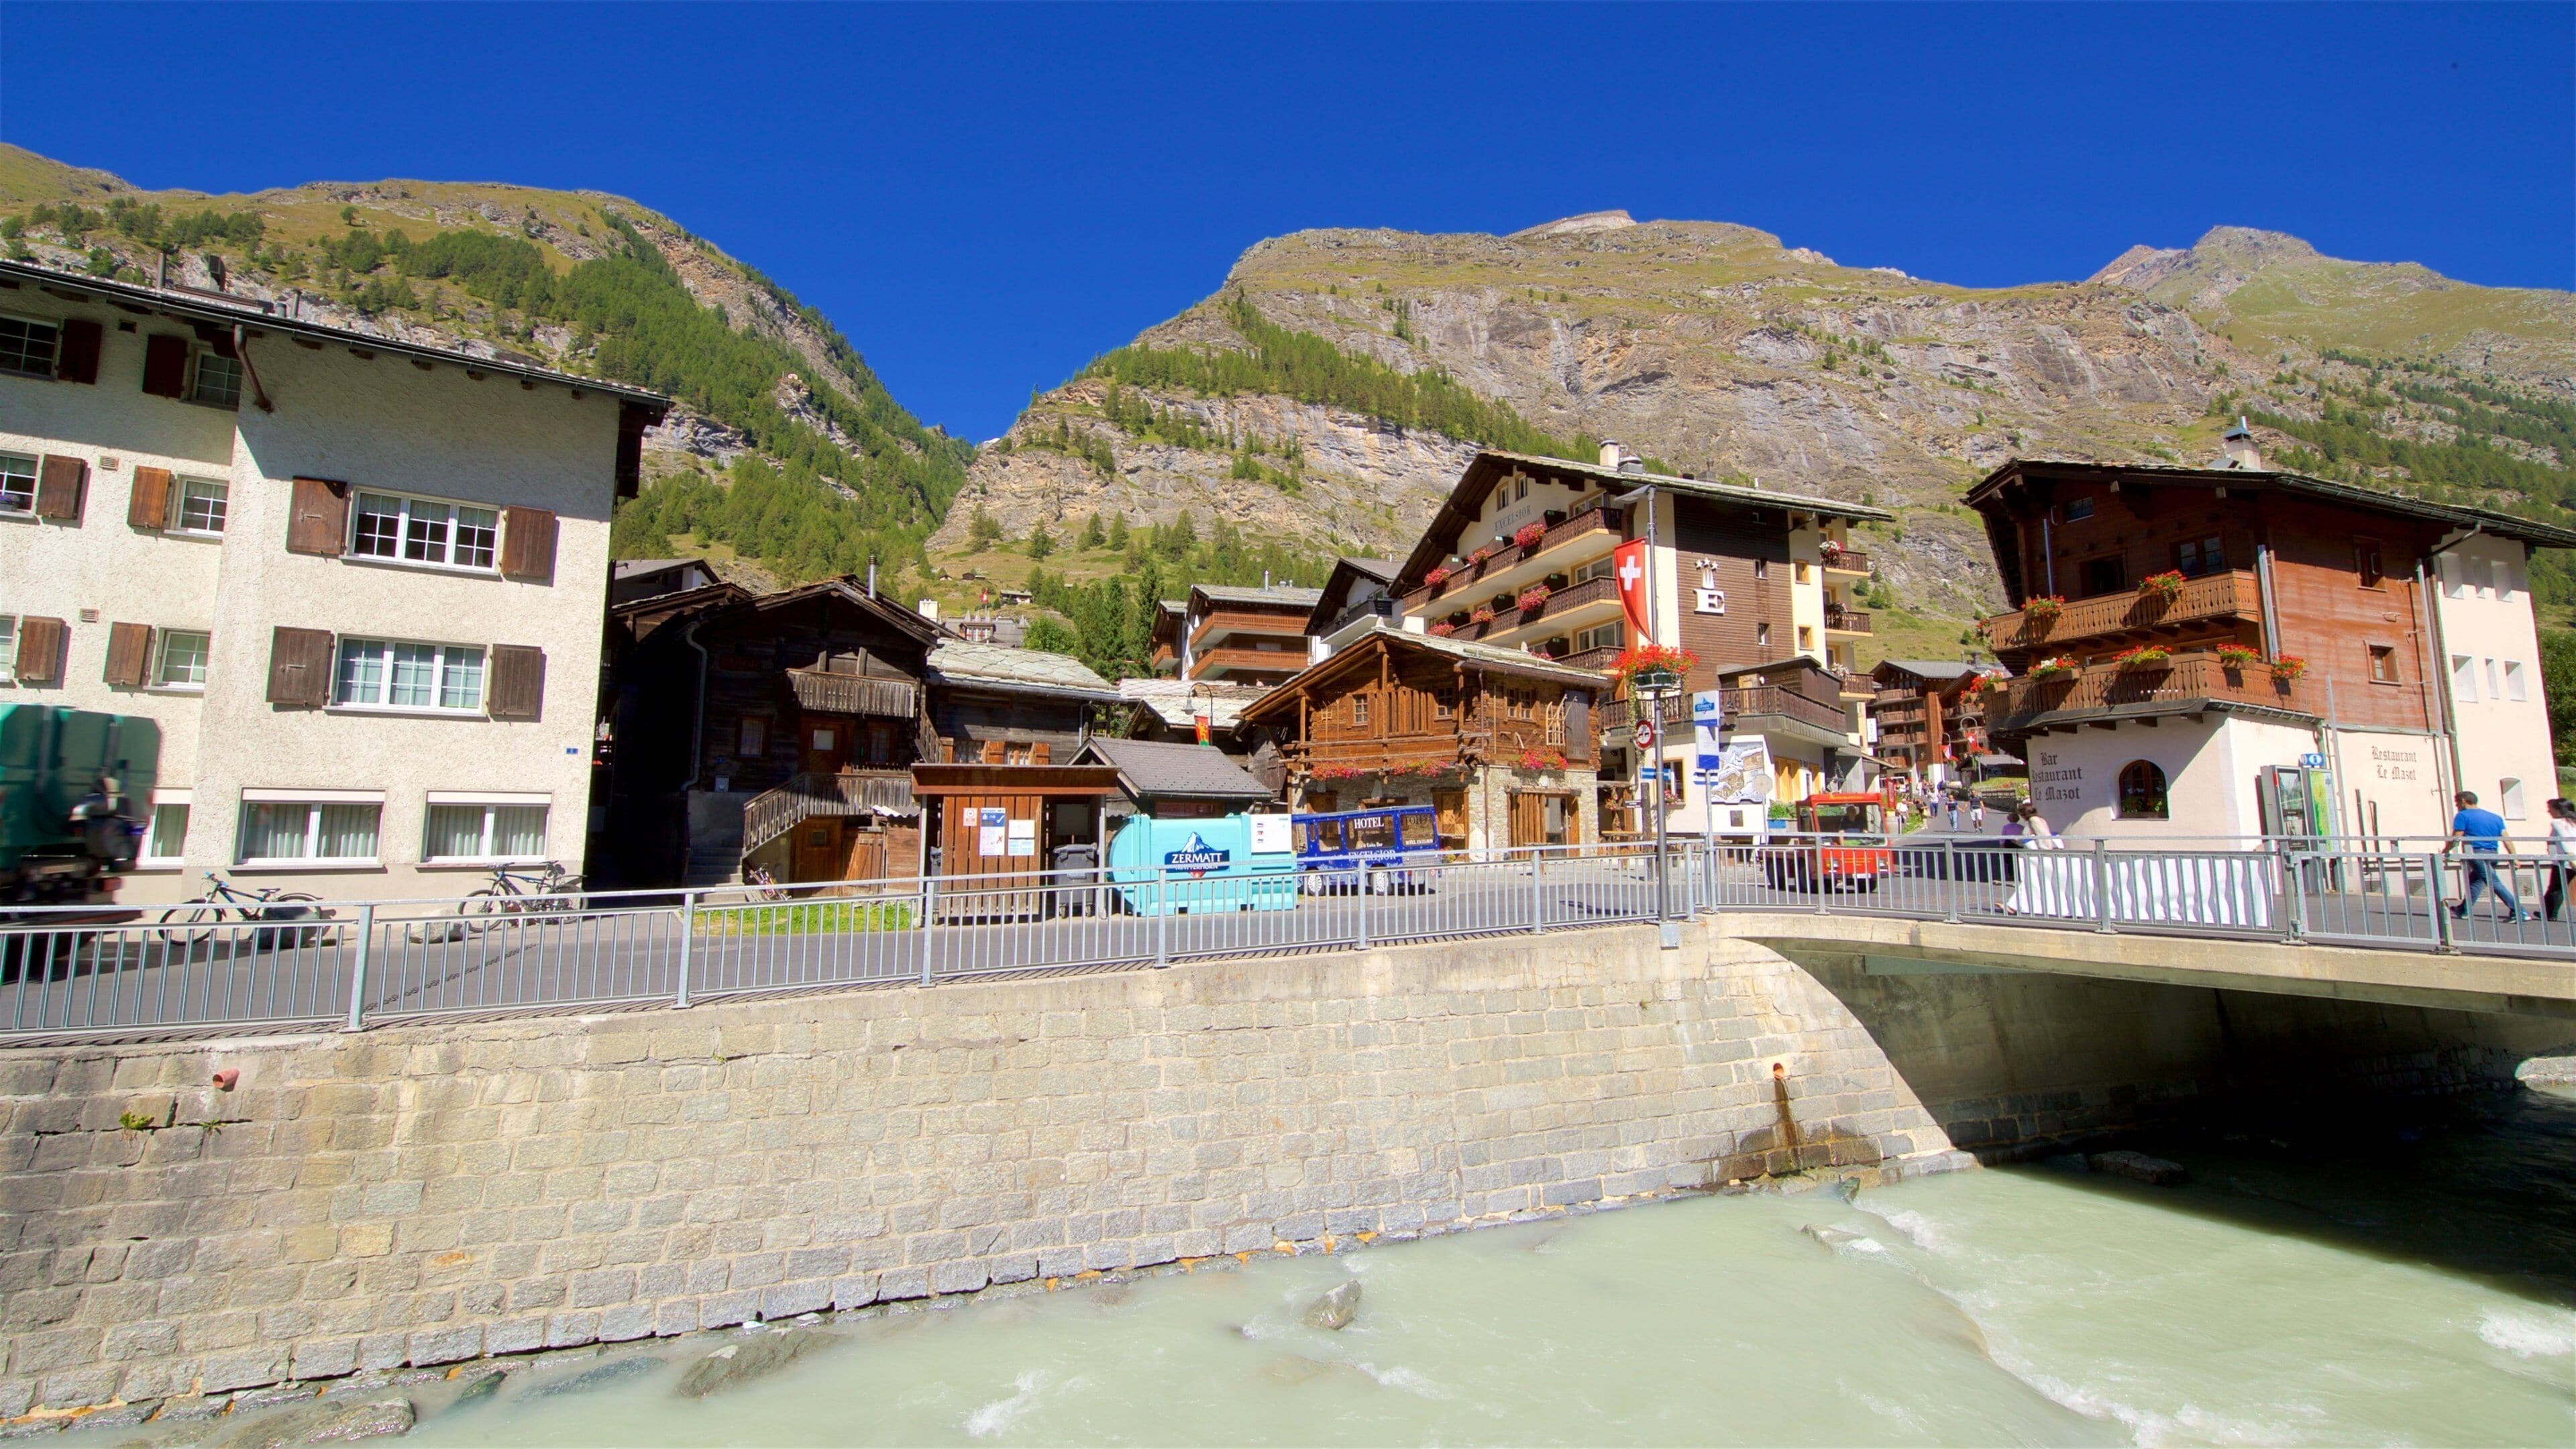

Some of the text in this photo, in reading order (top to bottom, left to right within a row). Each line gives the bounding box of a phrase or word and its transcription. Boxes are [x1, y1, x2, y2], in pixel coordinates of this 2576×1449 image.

[1495, 504, 1532, 531] EXCELSIOR
[2040, 752, 2057, 765] Bar
[2371, 745, 2417, 762] Restaurant
[2377, 765, 2417, 780] Le Mazot
[2035, 786, 2081, 800] Le Mazot
[1354, 816, 1385, 829] HOTEL
[1171, 853, 1222, 864] ZERMATT
